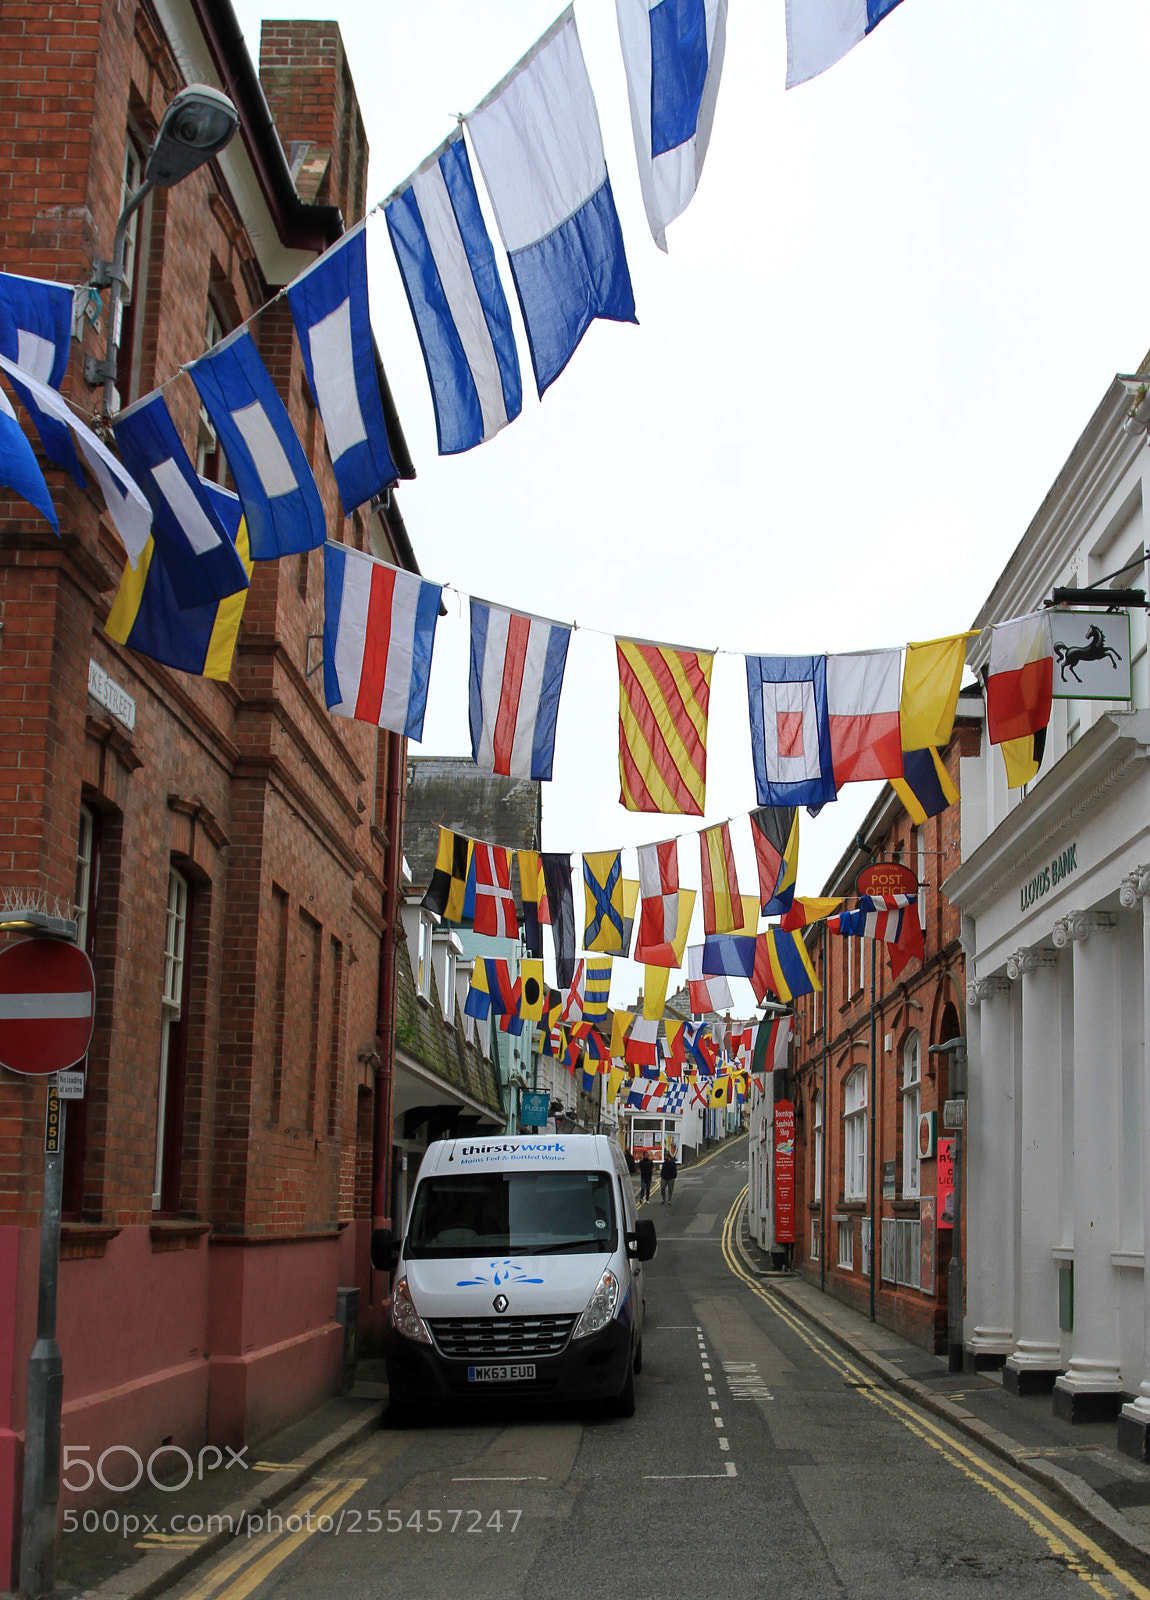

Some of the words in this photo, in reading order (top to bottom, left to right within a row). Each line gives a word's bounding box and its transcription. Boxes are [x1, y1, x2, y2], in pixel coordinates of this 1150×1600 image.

[103, 681, 133, 721] STREET
[871, 874, 903, 885] POST
[1020, 866, 1051, 912] LLOYDS
[1052, 842, 1077, 887] BANK
[776, 1119, 794, 1127] Sandwich
[780, 1128, 790, 1138] Shop
[462, 1143, 565, 1156] thirstywork
[461, 1157, 483, 1165] Mains
[475, 1367, 507, 1379] WK63
[510, 1366, 534, 1378] EUD
